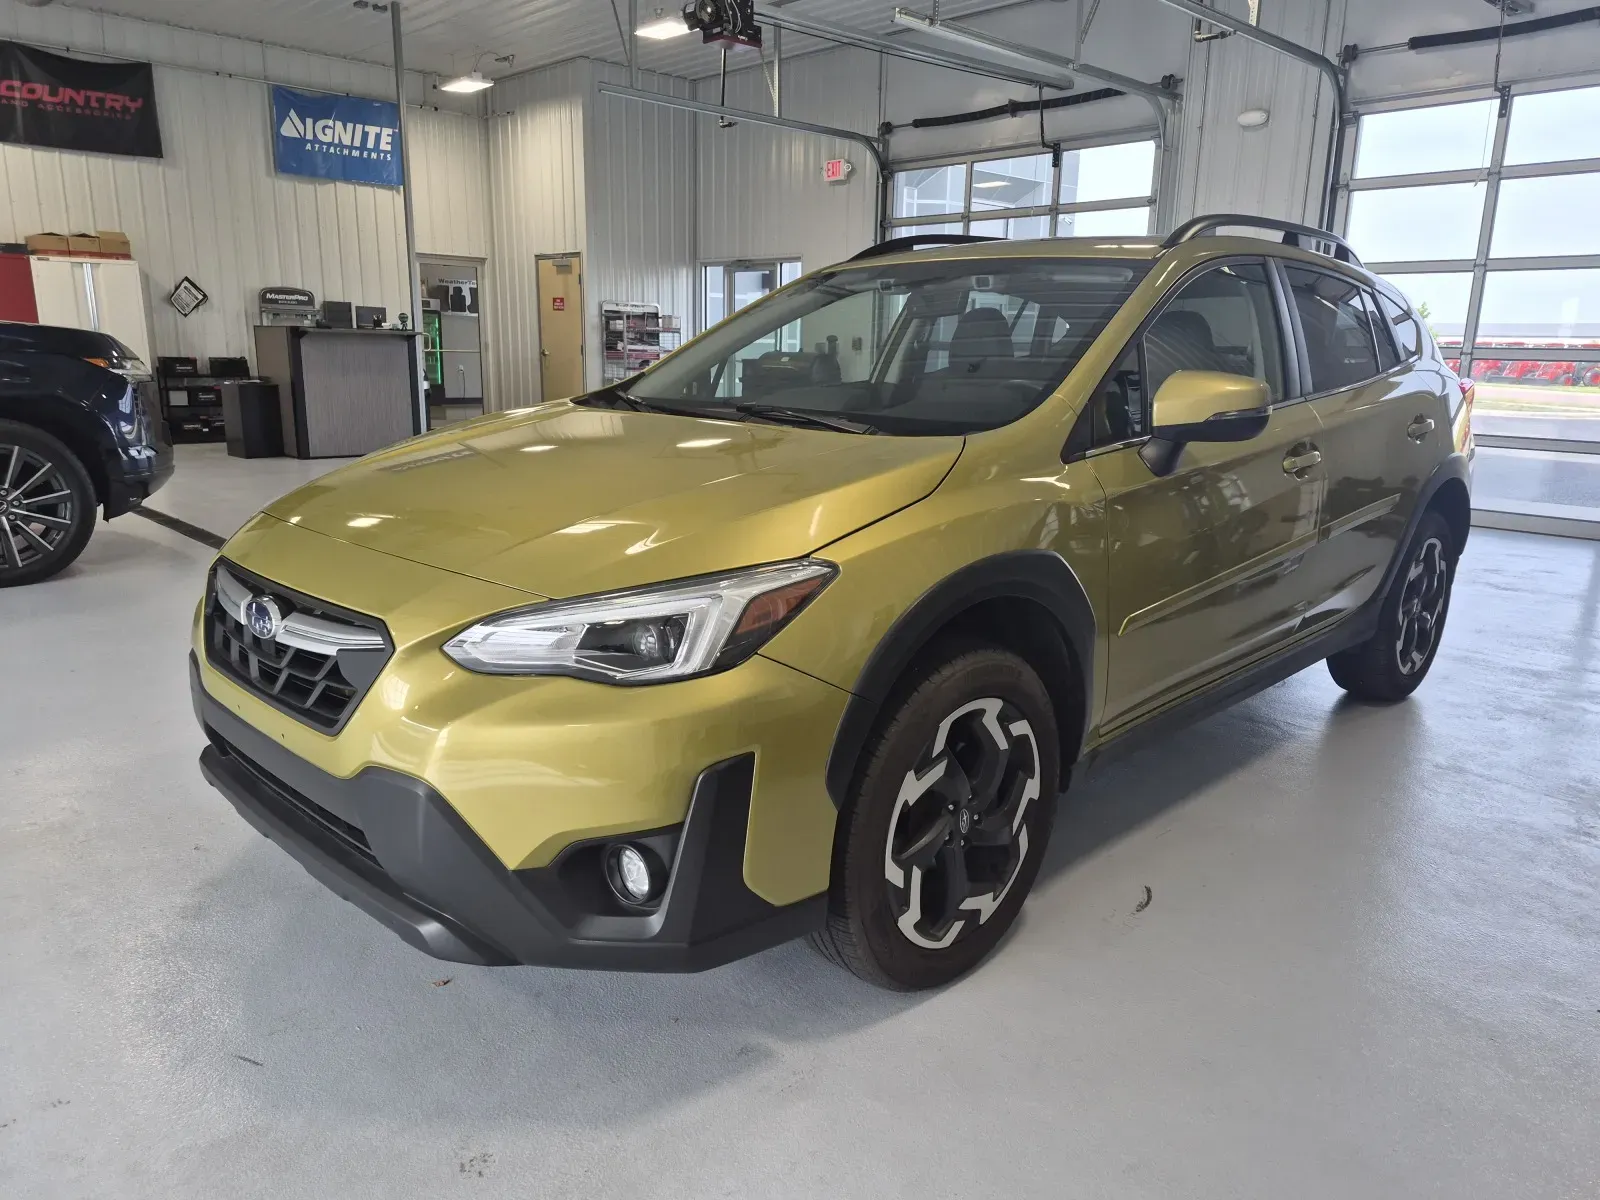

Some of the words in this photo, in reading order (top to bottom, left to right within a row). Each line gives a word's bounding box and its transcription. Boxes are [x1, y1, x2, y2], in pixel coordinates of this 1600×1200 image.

[0, 80, 143, 113] COUNTRY
[305, 117, 393, 151] IGNITE
[305, 142, 392, 161] ATTACHMENTS
[827, 161, 842, 177] EXIT
[438, 278, 477, 286] WeatherTe
